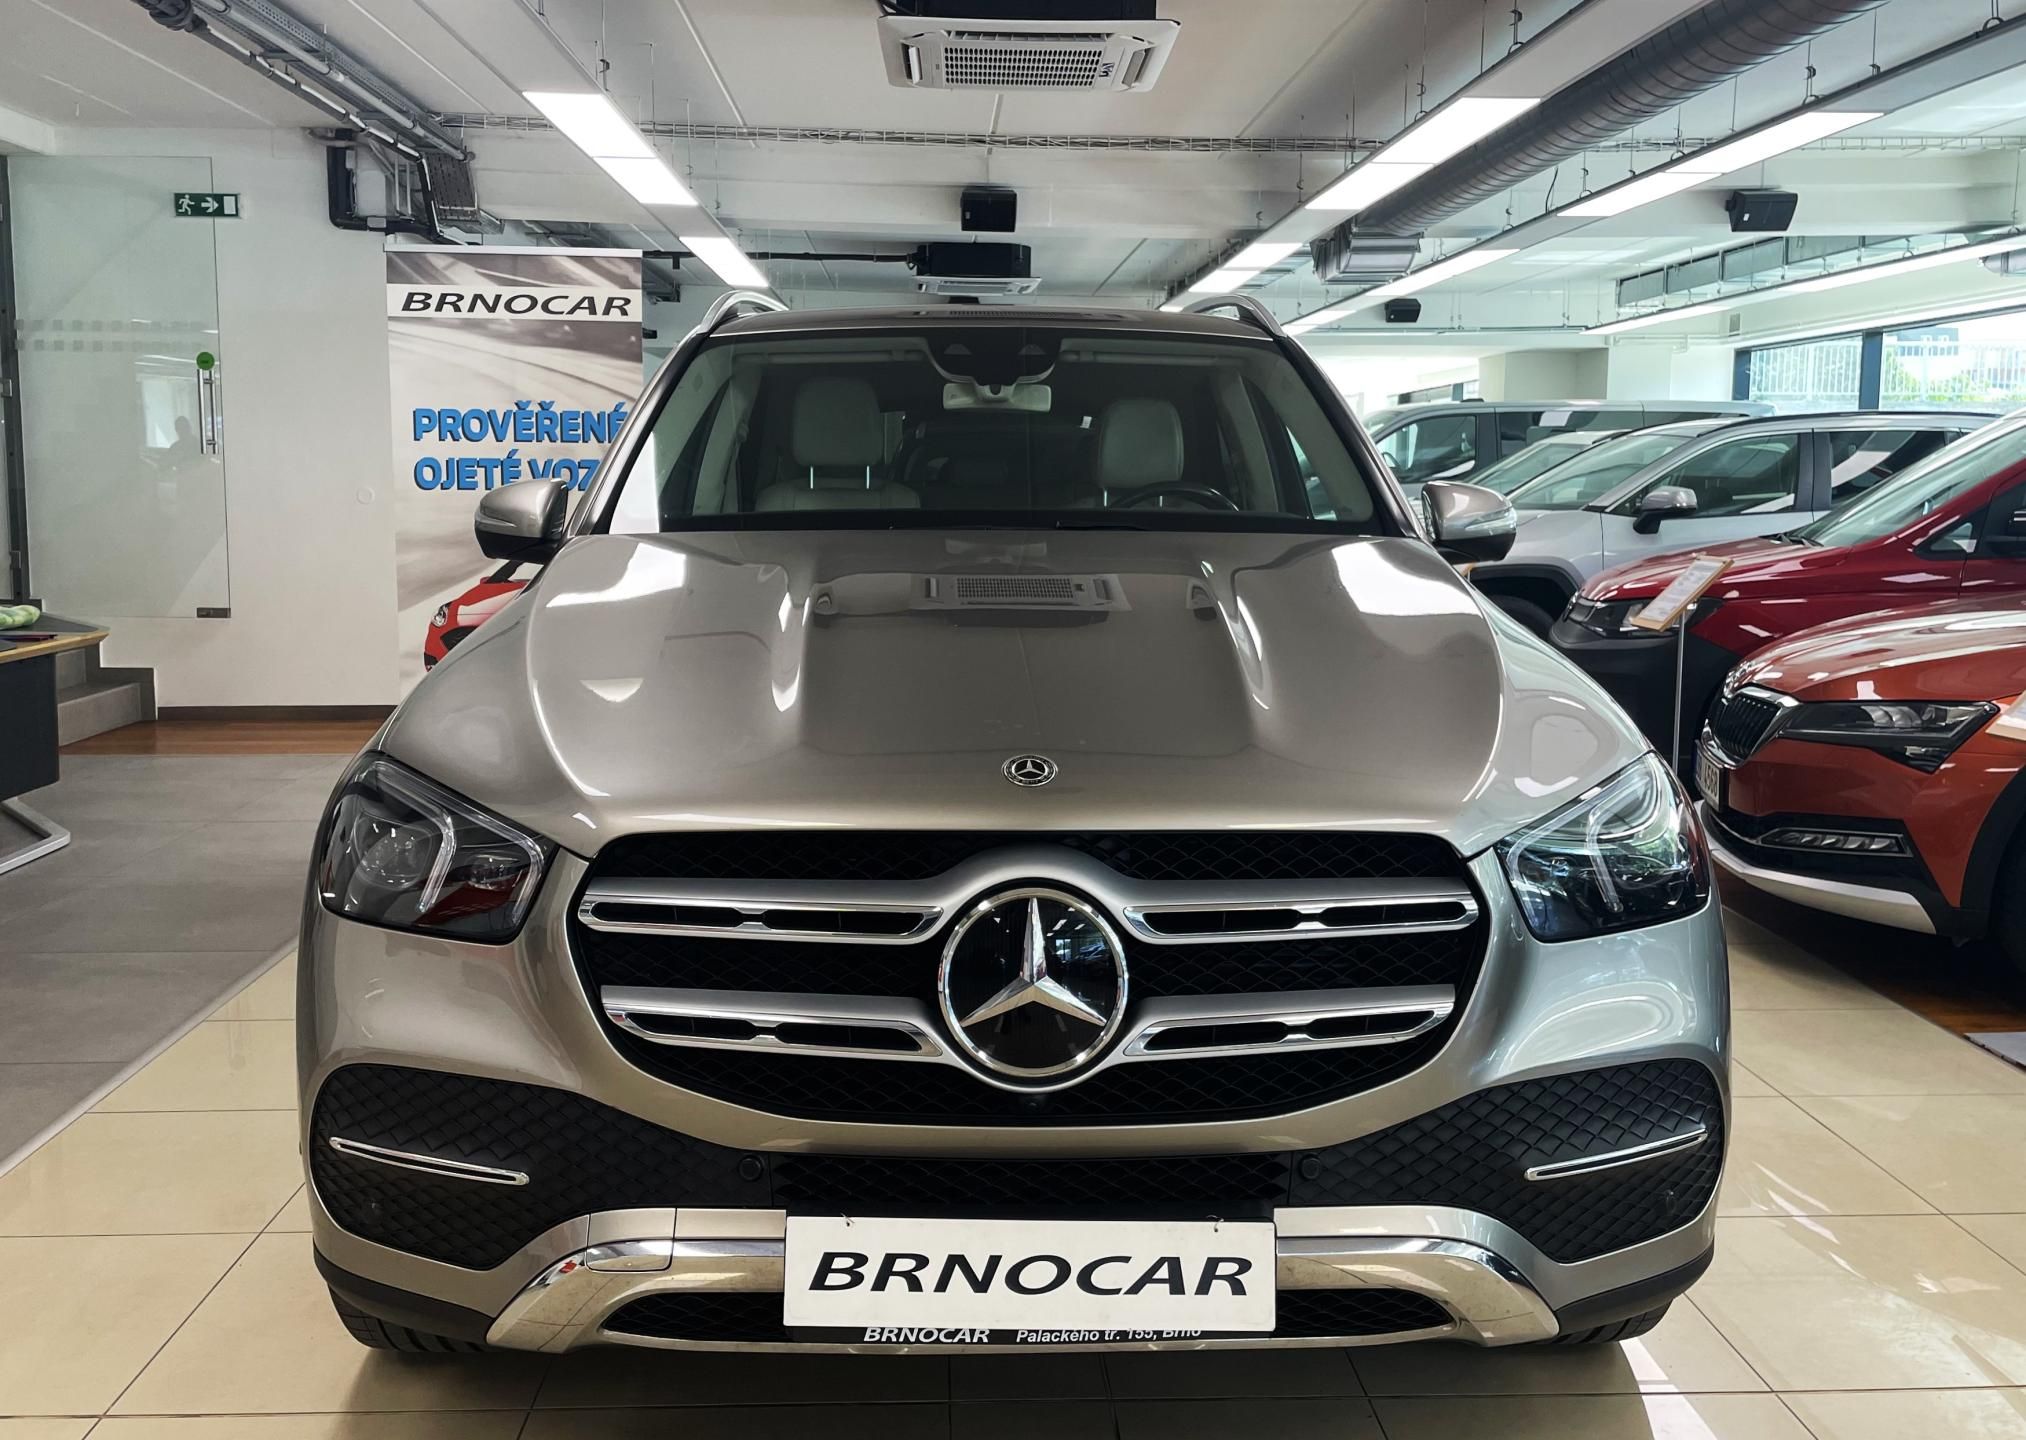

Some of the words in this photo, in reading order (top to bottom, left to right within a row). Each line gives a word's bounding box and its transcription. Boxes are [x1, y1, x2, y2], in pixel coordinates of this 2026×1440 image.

[401, 291, 632, 317] BRNOCAR
[412, 400, 628, 443] PROVĚŘENÉ
[414, 449, 522, 491] OJETÉ
[528, 458, 601, 491] VOZ
[808, 1251, 1253, 1296] BRNOCAR
[863, 1327, 991, 1343] BRNOCAR
